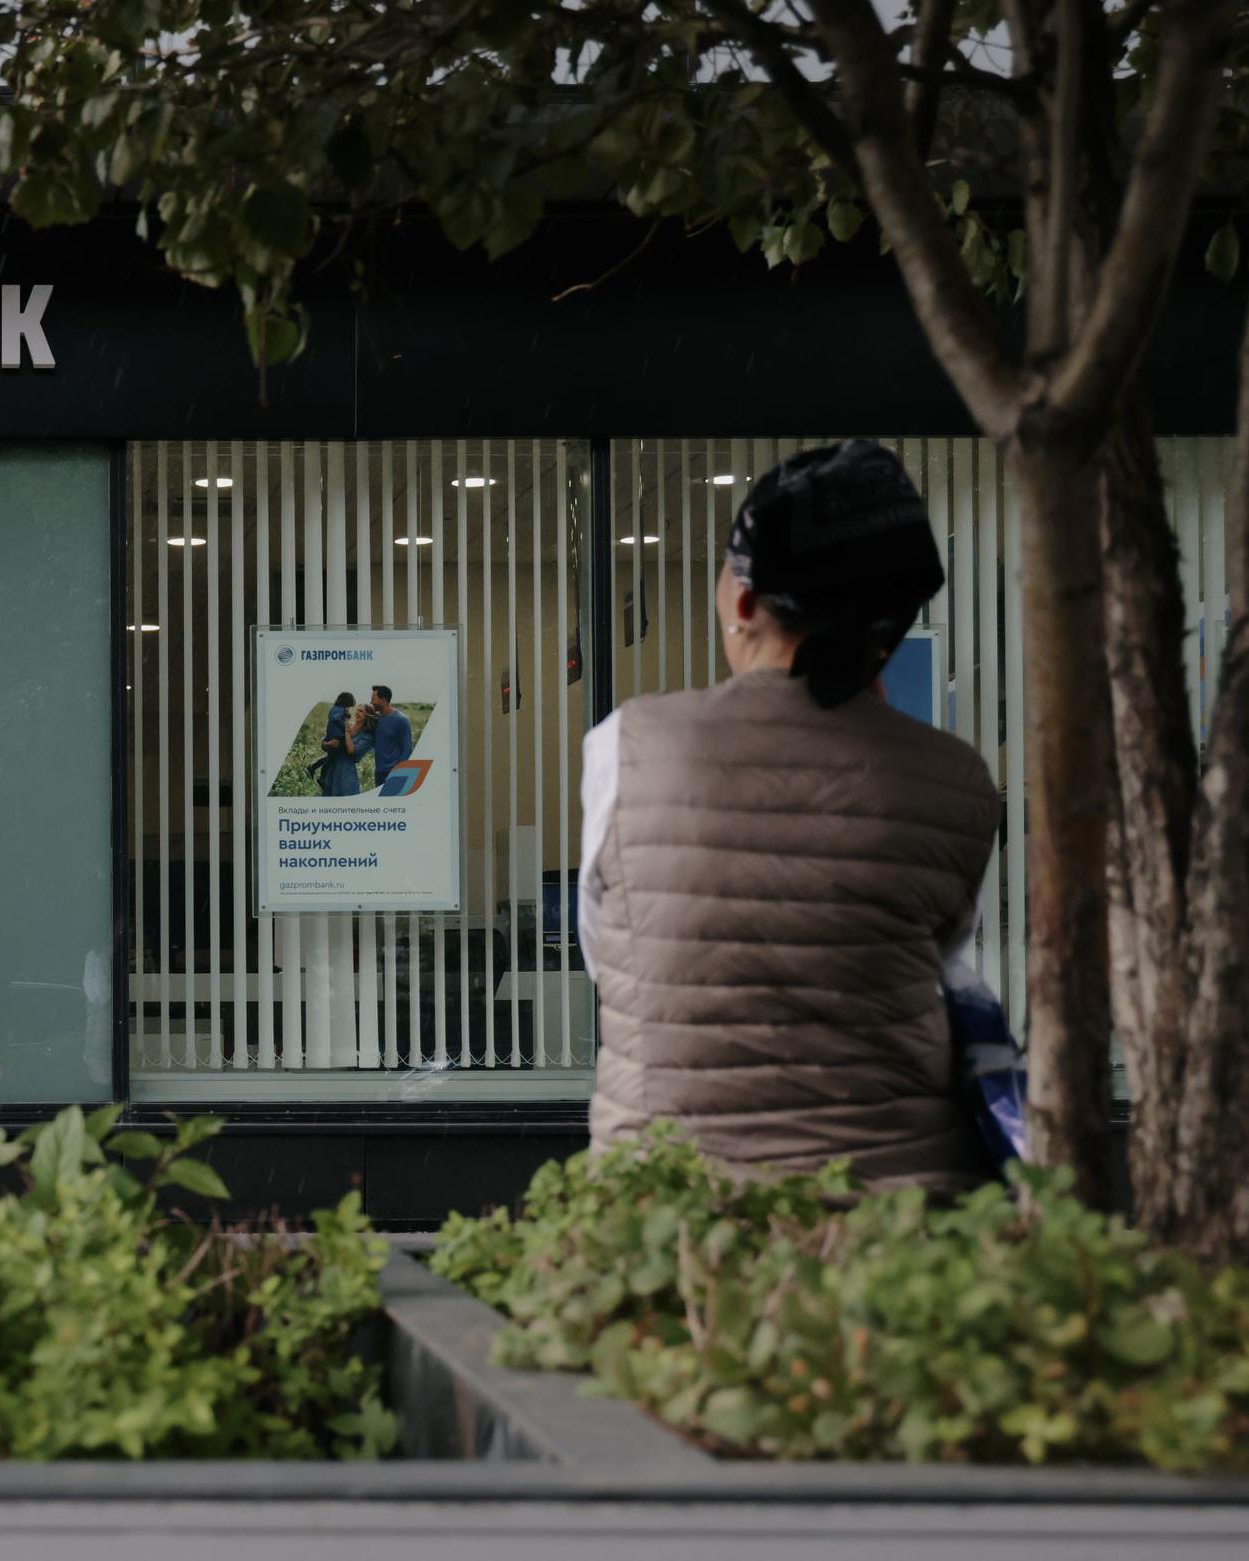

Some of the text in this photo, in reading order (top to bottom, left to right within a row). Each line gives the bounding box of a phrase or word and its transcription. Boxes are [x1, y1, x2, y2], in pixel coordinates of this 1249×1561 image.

[301, 649, 373, 661] ГАЗПРОМБАНК
[278, 806, 309, 815] Вклады
[278, 818, 407, 835] Приумножение
[278, 839, 332, 850] ваших
[279, 852, 378, 869] накоплений
[279, 879, 345, 891] gazprombank.ru
